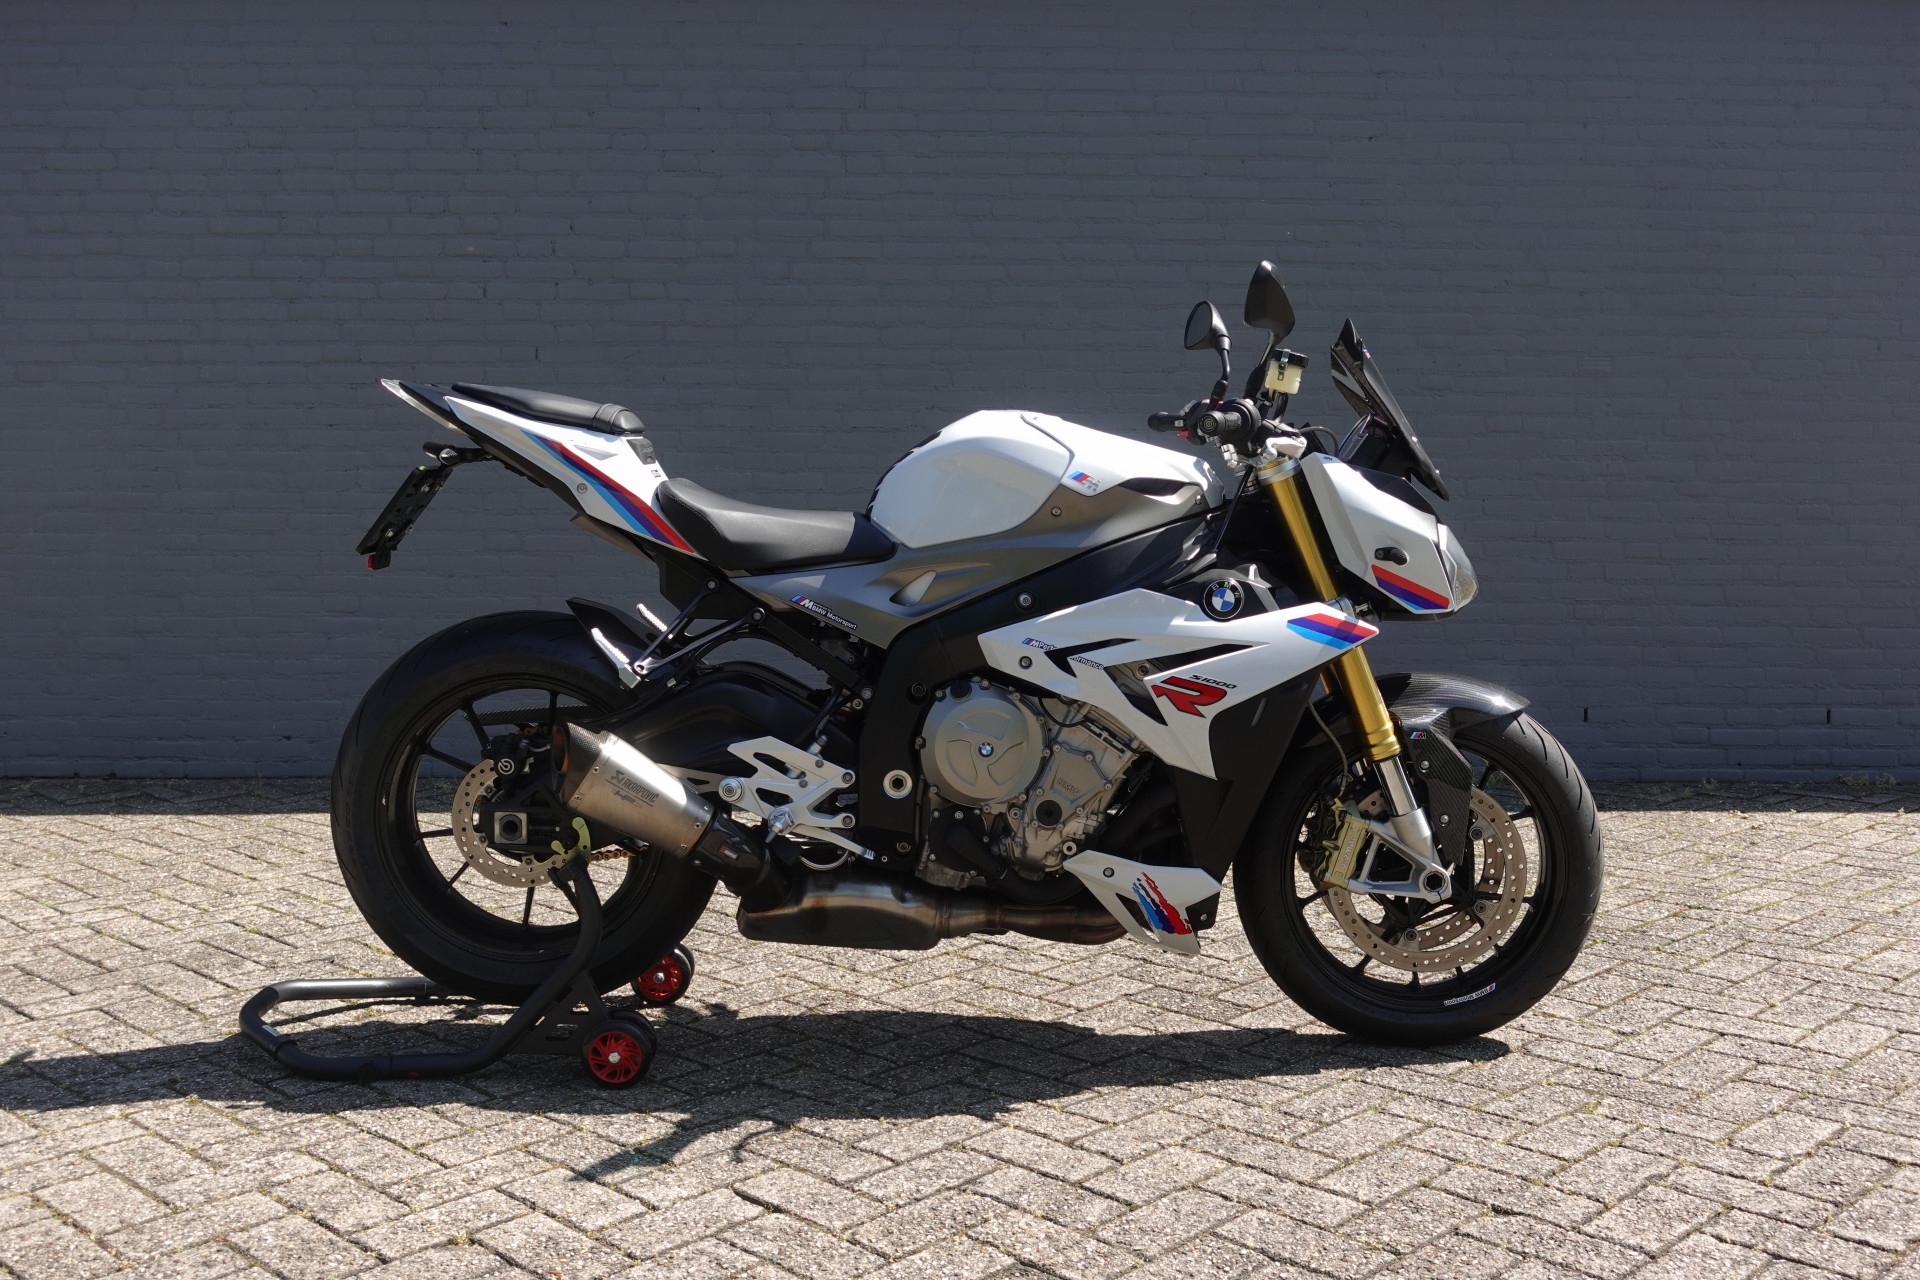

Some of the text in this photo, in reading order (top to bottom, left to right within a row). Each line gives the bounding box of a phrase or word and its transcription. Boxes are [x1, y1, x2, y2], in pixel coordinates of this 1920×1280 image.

[1211, 581, 1241, 599] BMW
[811, 605, 827, 616] BMW
[827, 612, 857, 630] Motorsport
[1189, 674, 1238, 690] S1000
[1151, 676, 1227, 718] R
